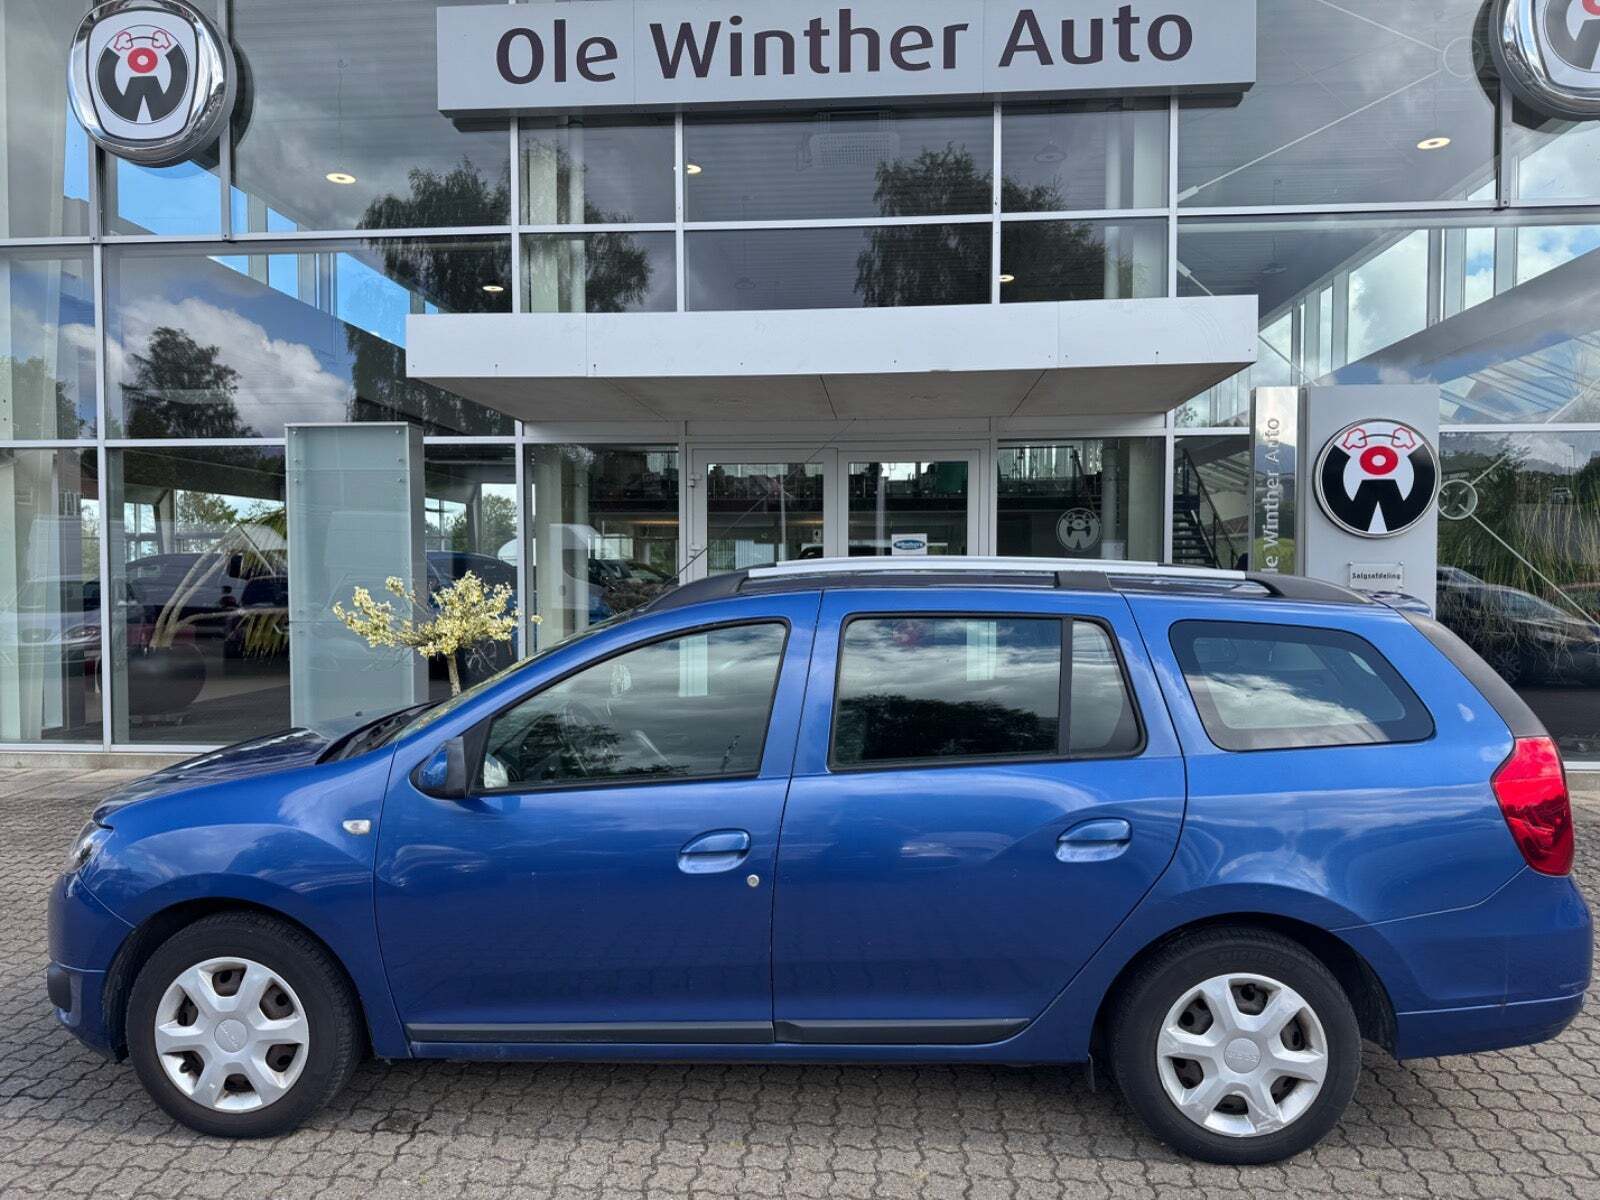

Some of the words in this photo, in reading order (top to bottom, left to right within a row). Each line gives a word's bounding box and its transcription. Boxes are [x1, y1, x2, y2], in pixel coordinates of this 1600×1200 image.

[497, 19, 618, 85] Ole
[650, 8, 969, 80] Winther
[999, 4, 1193, 68] Auto
[1265, 418, 1280, 463] Auto
[1261, 470, 1280, 550] Winther
[1261, 554, 1279, 575] le
[1351, 571, 1401, 581] Salgsafdeling
